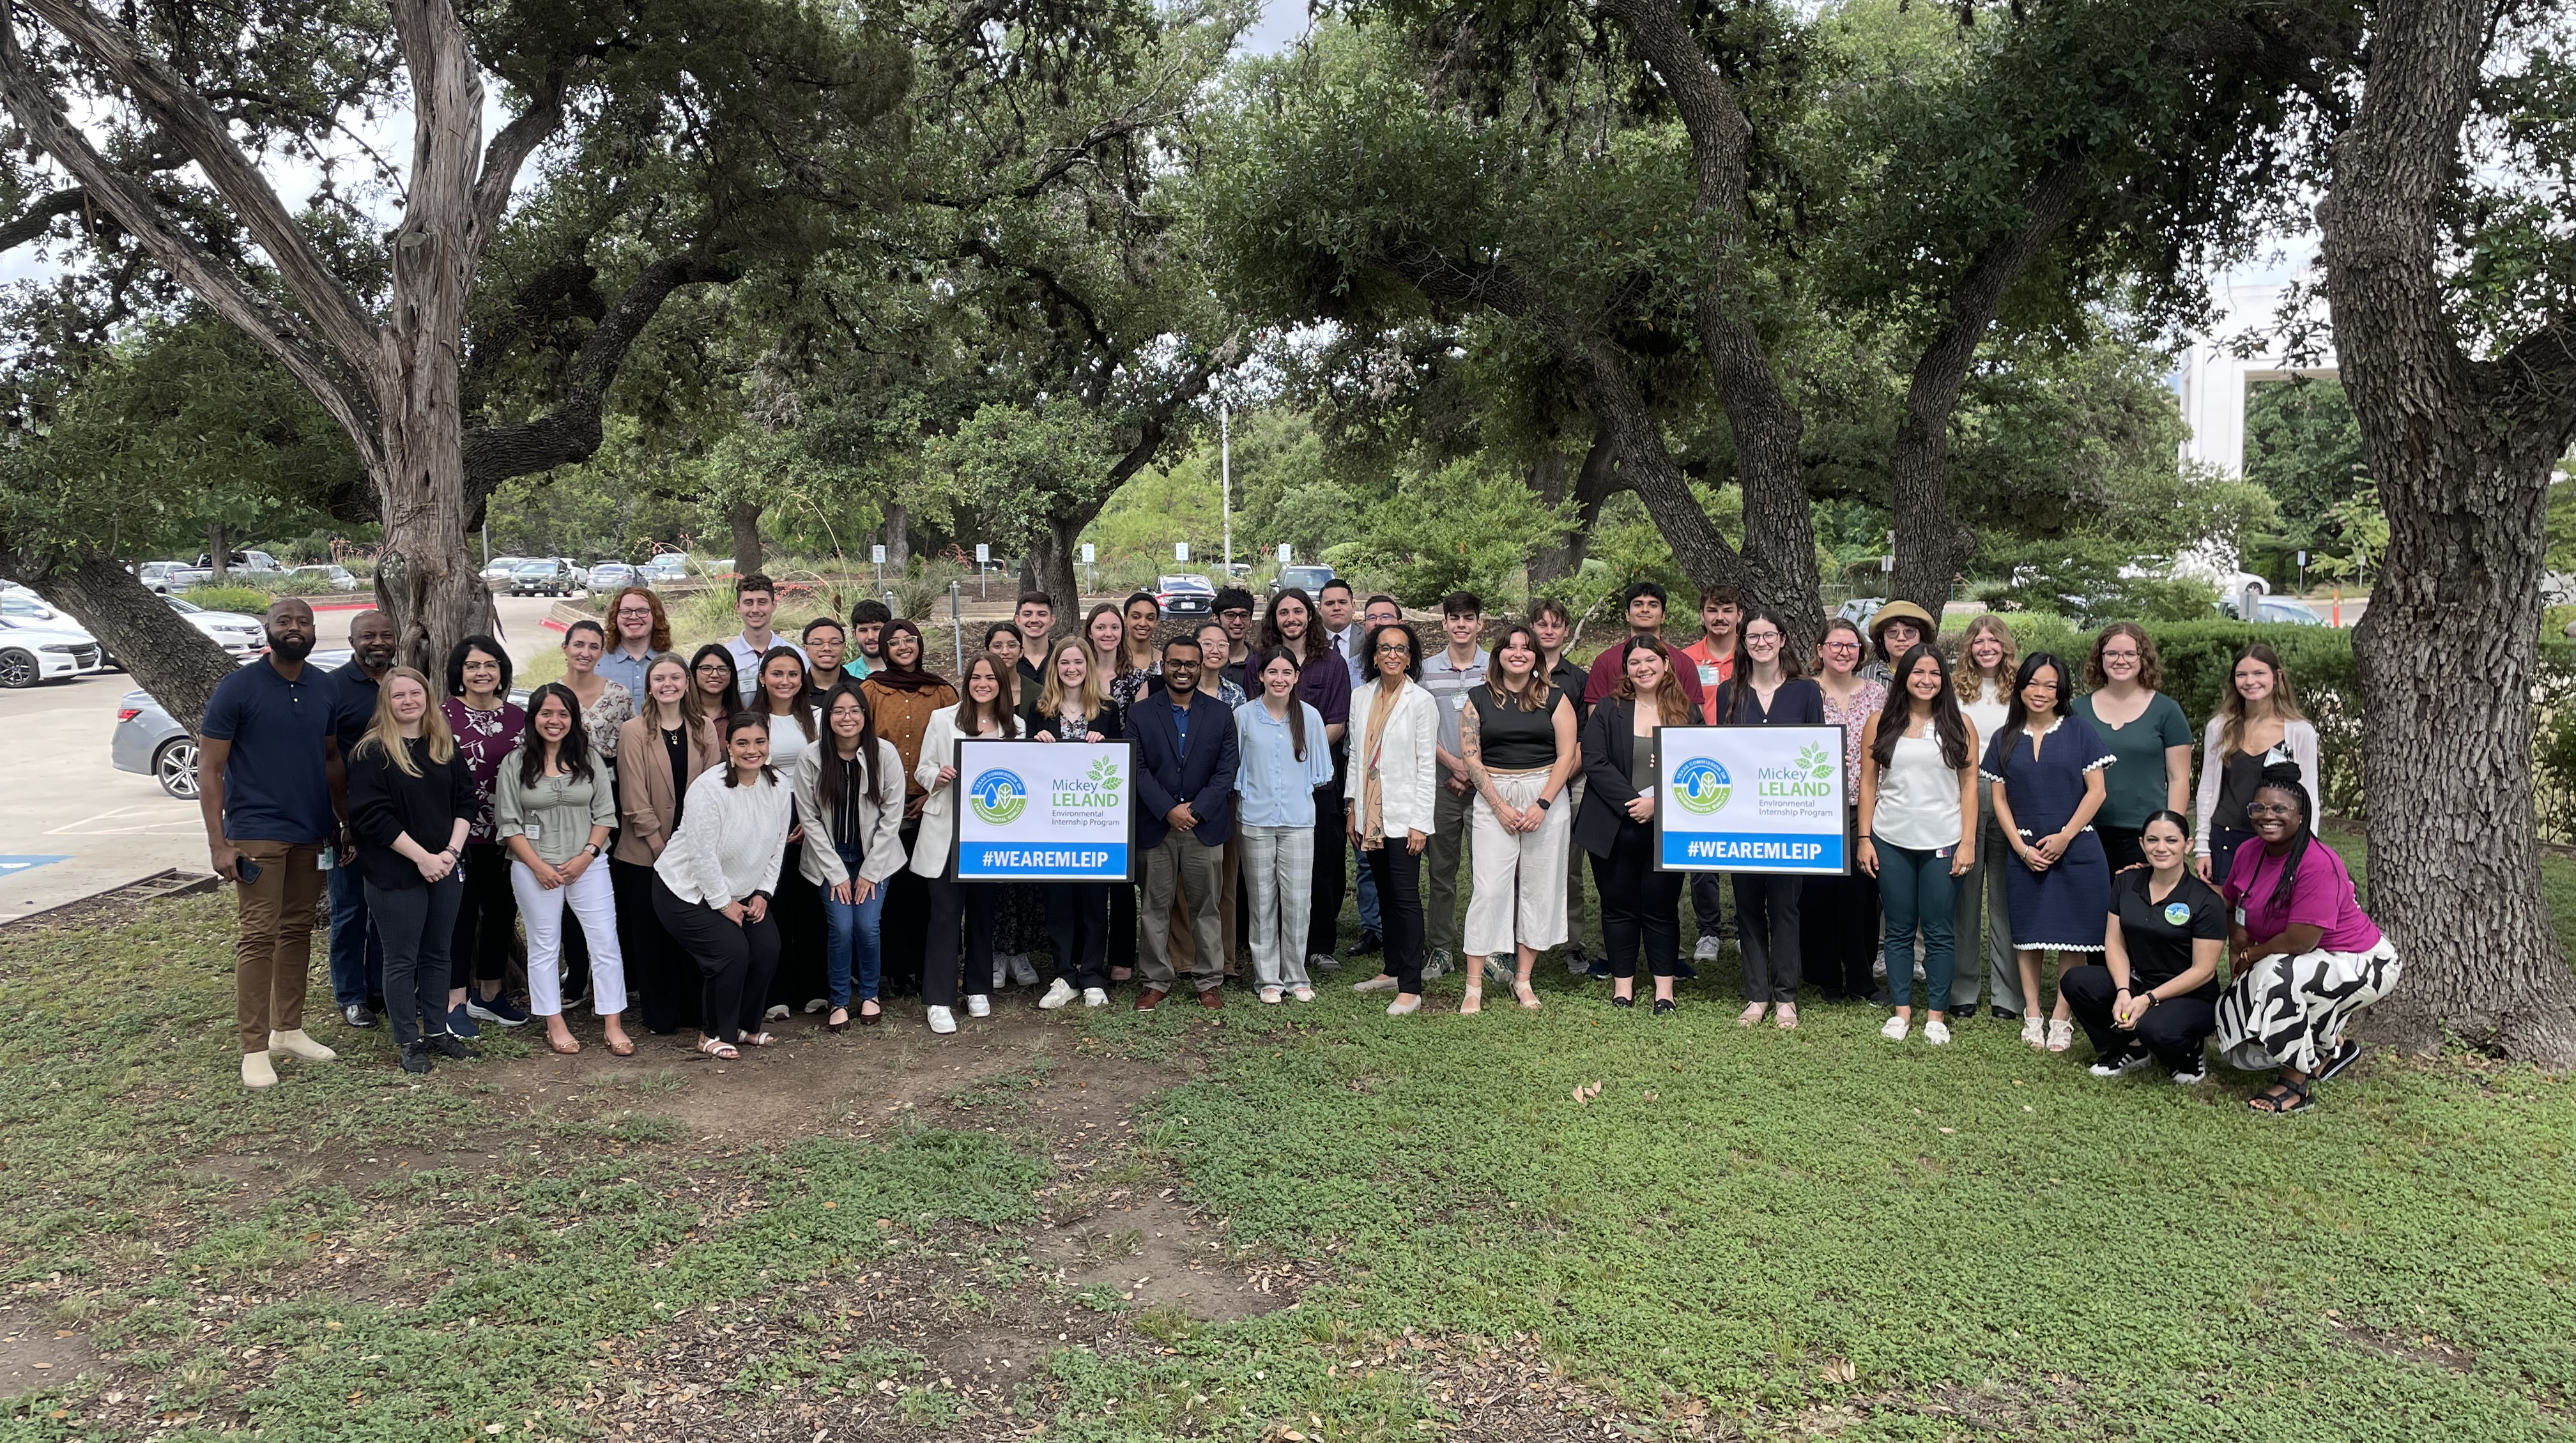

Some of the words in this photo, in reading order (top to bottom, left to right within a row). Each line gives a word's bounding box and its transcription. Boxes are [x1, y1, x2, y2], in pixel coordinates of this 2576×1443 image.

[1676, 765, 1689, 779] TEXAS
[1758, 767, 1807, 783] Mickey
[974, 776, 987, 790] TEXAS
[1052, 779, 1098, 793] Mickey
[1758, 782, 1831, 797] LELAND
[1052, 793, 1119, 807] LELAND
[1759, 808, 1798, 816] Internship
[1800, 809, 1833, 818] Program
[1687, 841, 1821, 860] #WEAREMLEIP
[983, 851, 1108, 867] #WEAREMLEIP
